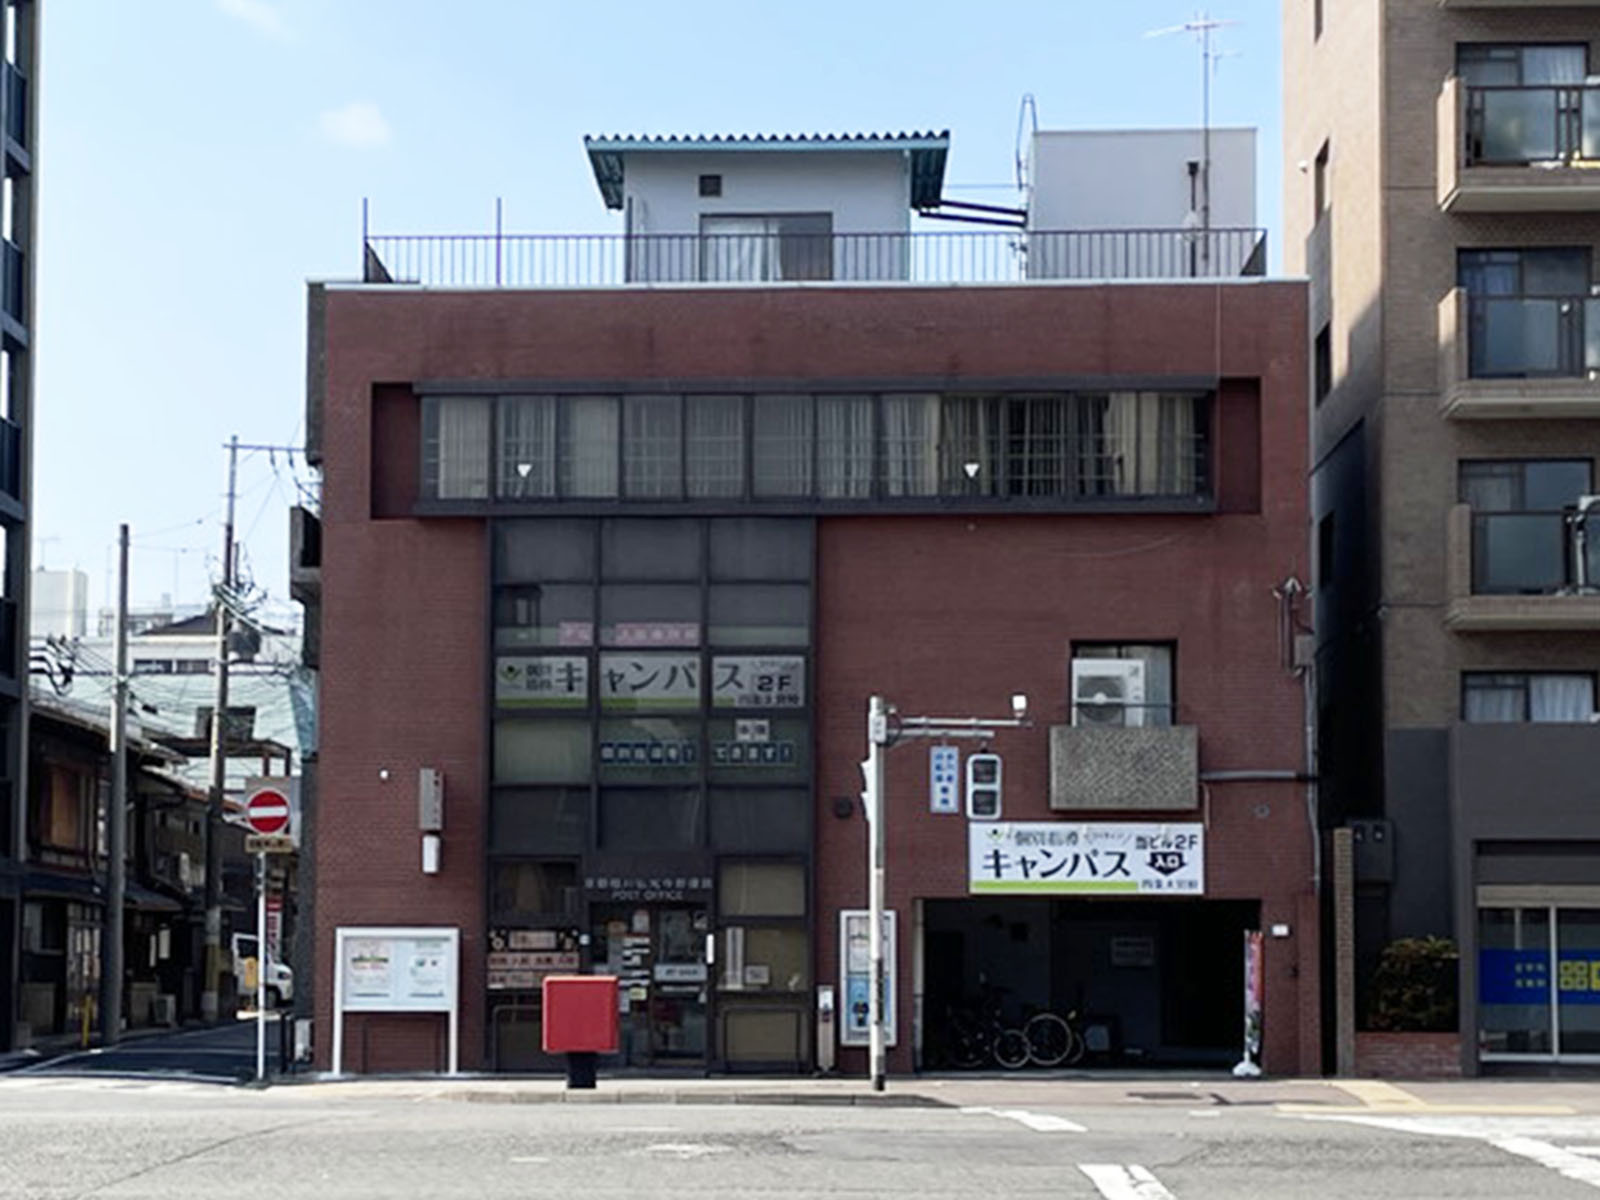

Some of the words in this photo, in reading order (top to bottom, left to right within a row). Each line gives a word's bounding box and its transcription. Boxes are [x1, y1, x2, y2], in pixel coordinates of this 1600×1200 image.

[757, 674, 792, 692] 2F
[982, 848, 1131, 879] キャンパス
[1153, 854, 1181, 869] 入口
[611, 890, 641, 900] POST
[643, 890, 684, 900] OFFICE
